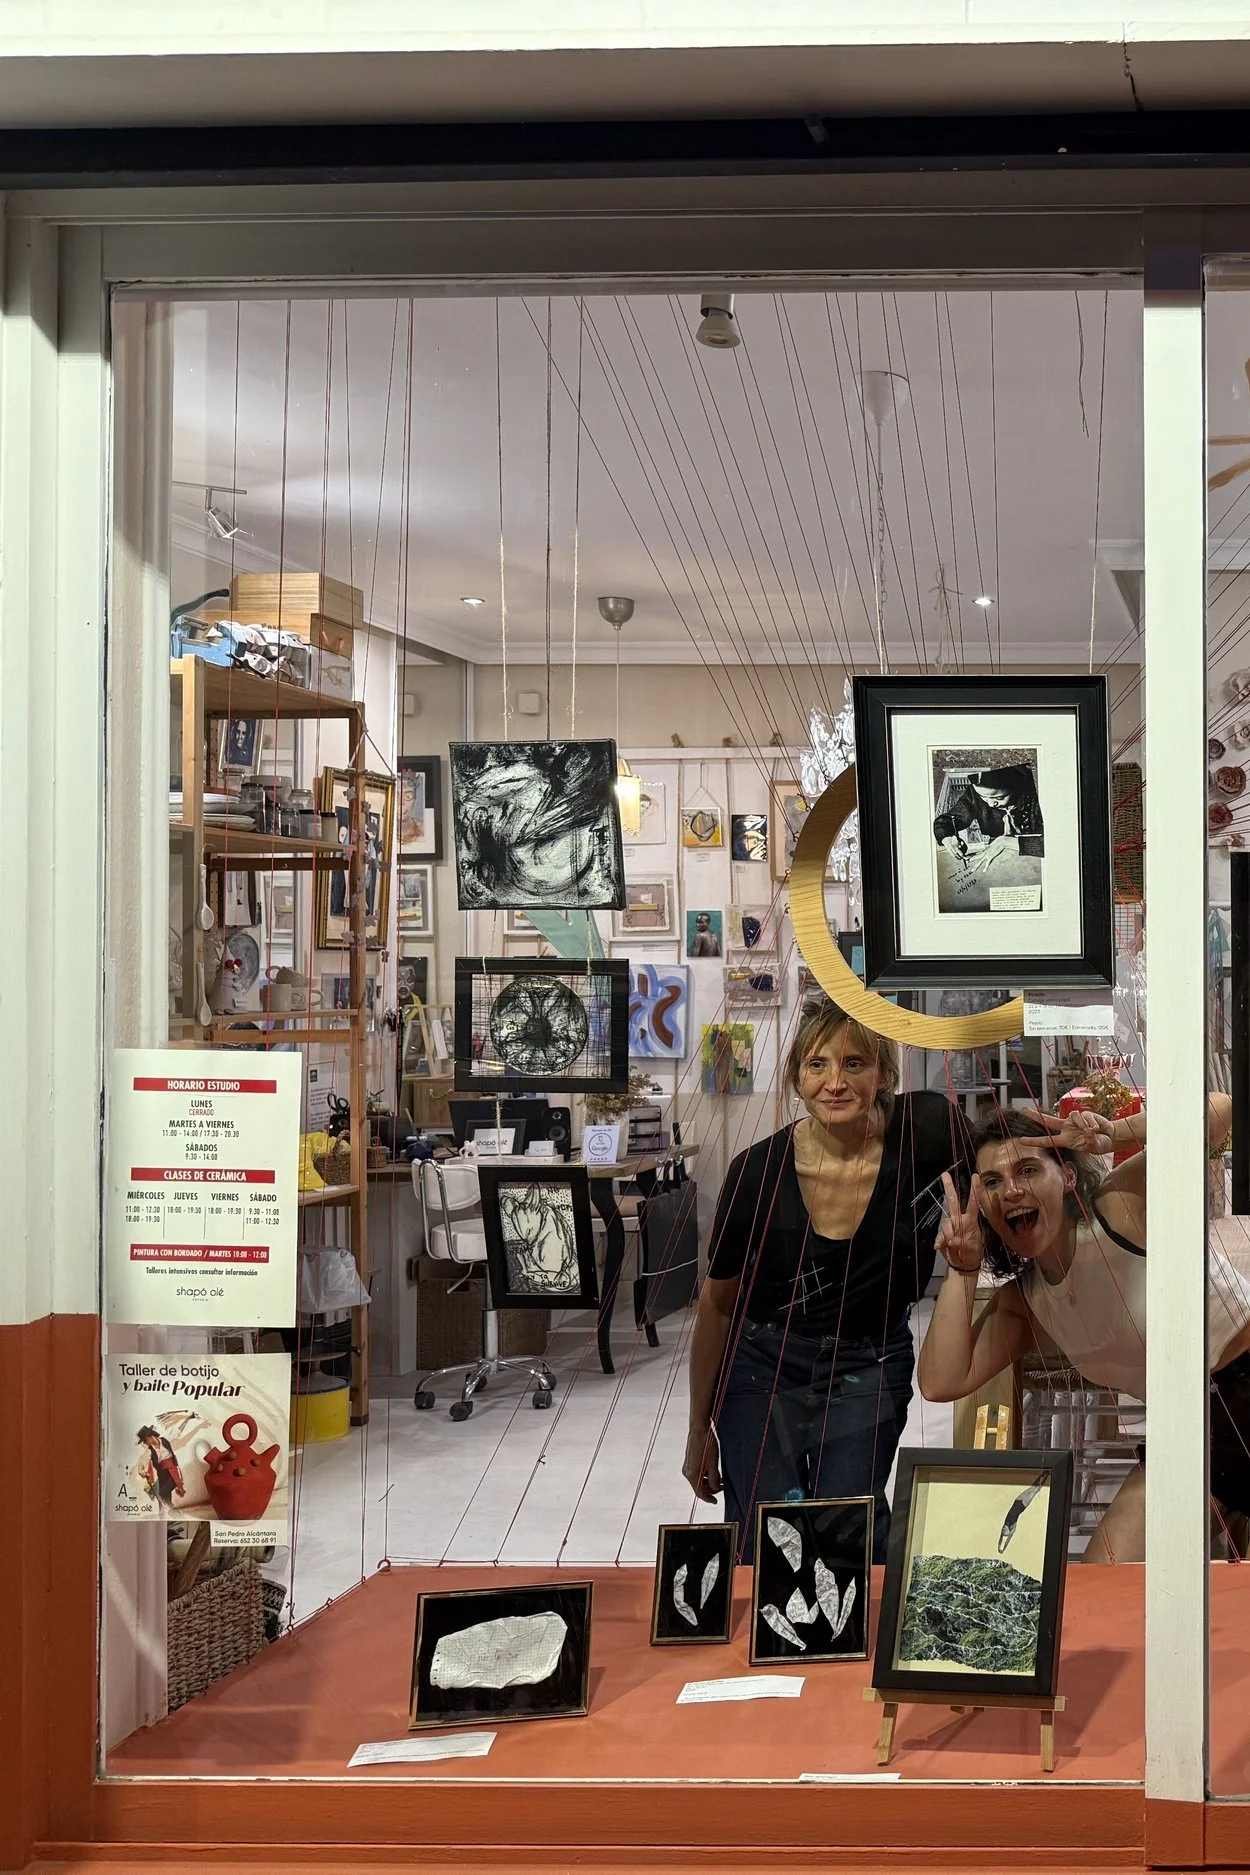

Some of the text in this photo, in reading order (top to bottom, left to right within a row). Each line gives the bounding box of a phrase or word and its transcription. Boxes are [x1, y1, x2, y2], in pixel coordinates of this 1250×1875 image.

[167, 1080, 240, 1091] HORARIO ESTUDIO
[191, 1100, 212, 1108] LUNES
[169, 1120, 235, 1128] MARTES A VIERNES
[185, 1142, 217, 1152] SÁBADOS
[164, 1169, 246, 1181] CLASES DE CERÁMICA
[127, 1190, 165, 1200] MIÉRCOLES
[173, 1192, 198, 1200] JUEVES
[211, 1193, 239, 1201] VIERNES
[249, 1192, 277, 1202] SÁBADO
[173, 1249, 202, 1257] BORDADO
[168, 1267, 197, 1275] intensivos
[199, 1268, 224, 1276] consultar
[225, 1268, 258, 1276] información
[176, 1287, 224, 1298] shapó olé
[119, 1363, 219, 1380] Taller de botijo
[121, 1379, 246, 1400] y baile Popular
[115, 1503, 153, 1513] shapó olé
